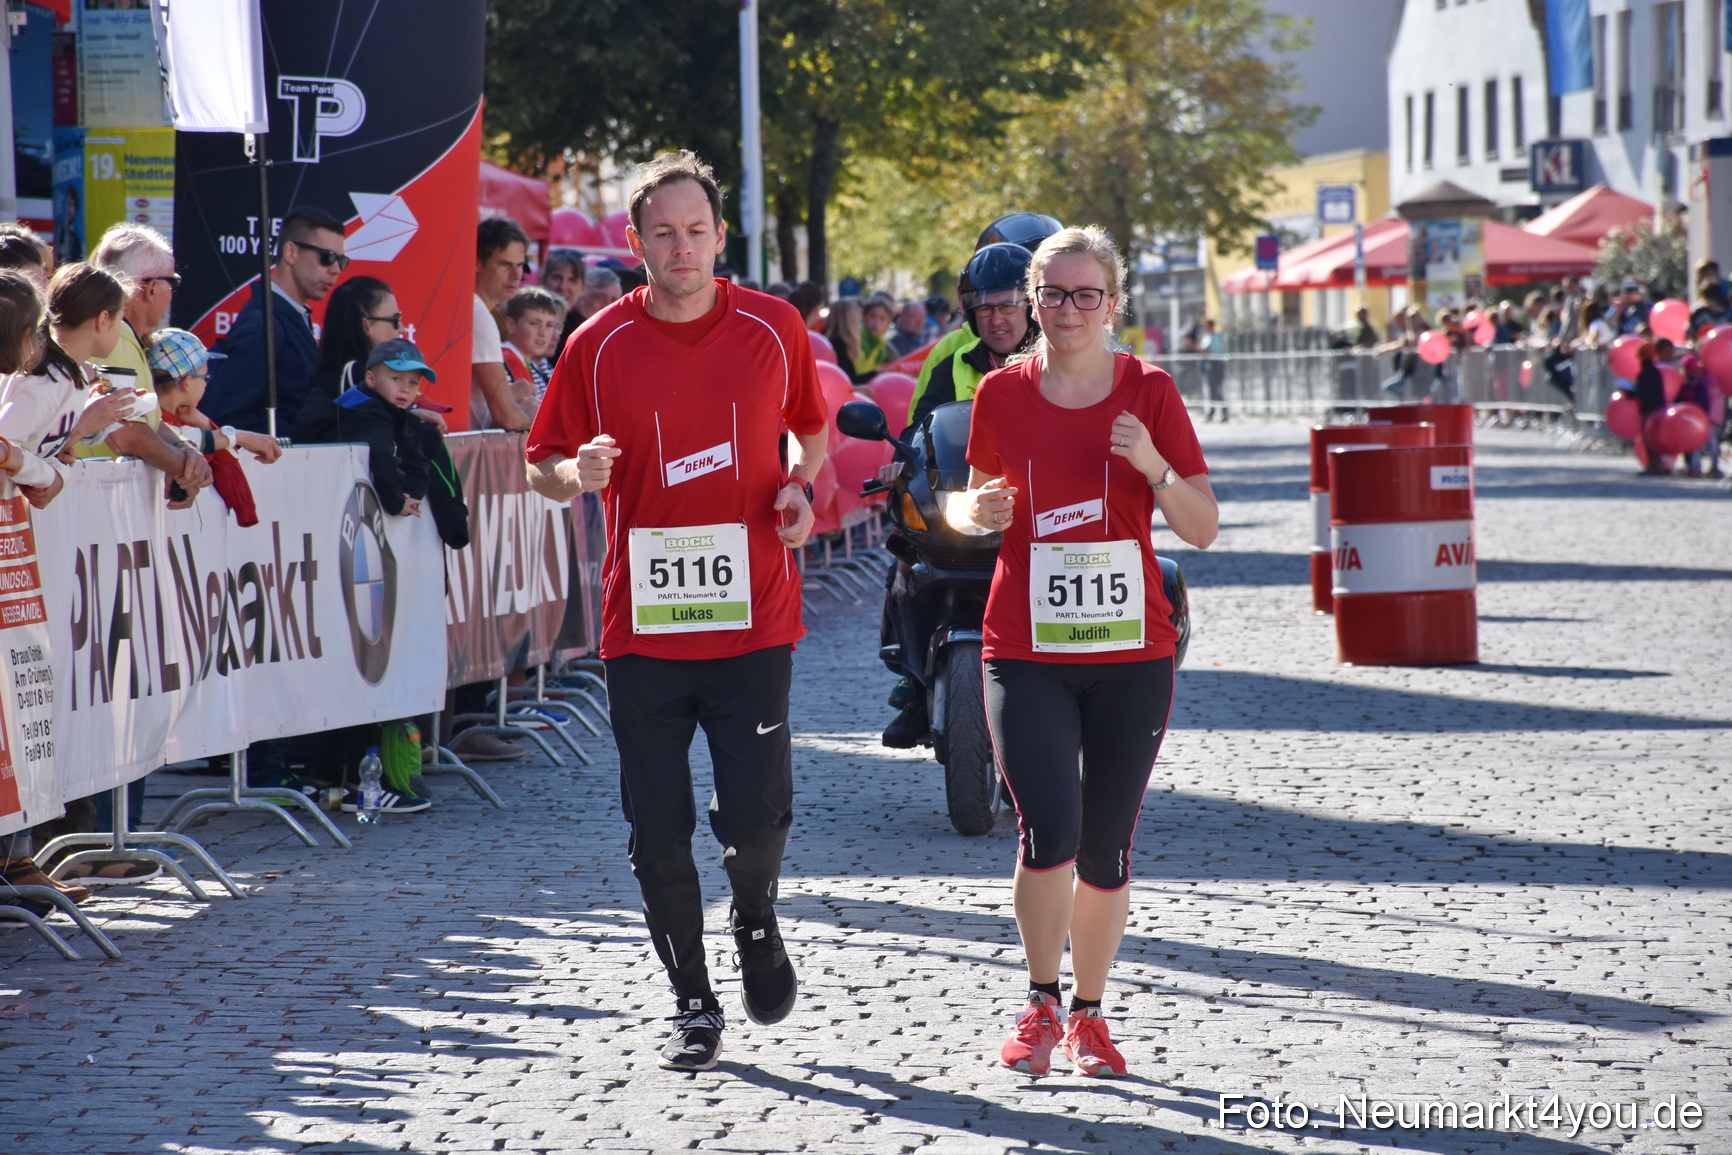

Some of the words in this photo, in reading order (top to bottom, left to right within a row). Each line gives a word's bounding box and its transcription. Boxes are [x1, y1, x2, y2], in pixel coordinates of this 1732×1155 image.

[283, 82, 310, 93] Team
[311, 84, 335, 95] Partl
[89, 152, 123, 180] 19.
[246, 216, 284, 237] TE
[218, 235, 248, 255] 100
[685, 455, 714, 474] DEHN
[1053, 509, 1085, 526] DEHN
[664, 535, 715, 549] BOCK
[1064, 552, 1111, 565] BOCK
[649, 555, 733, 588] 5116
[1048, 573, 1128, 607] 5115
[70, 540, 181, 711] PARTL
[167, 521, 323, 687] Nearkt
[672, 607, 714, 621] Lukas
[1068, 626, 1110, 641] Judith
